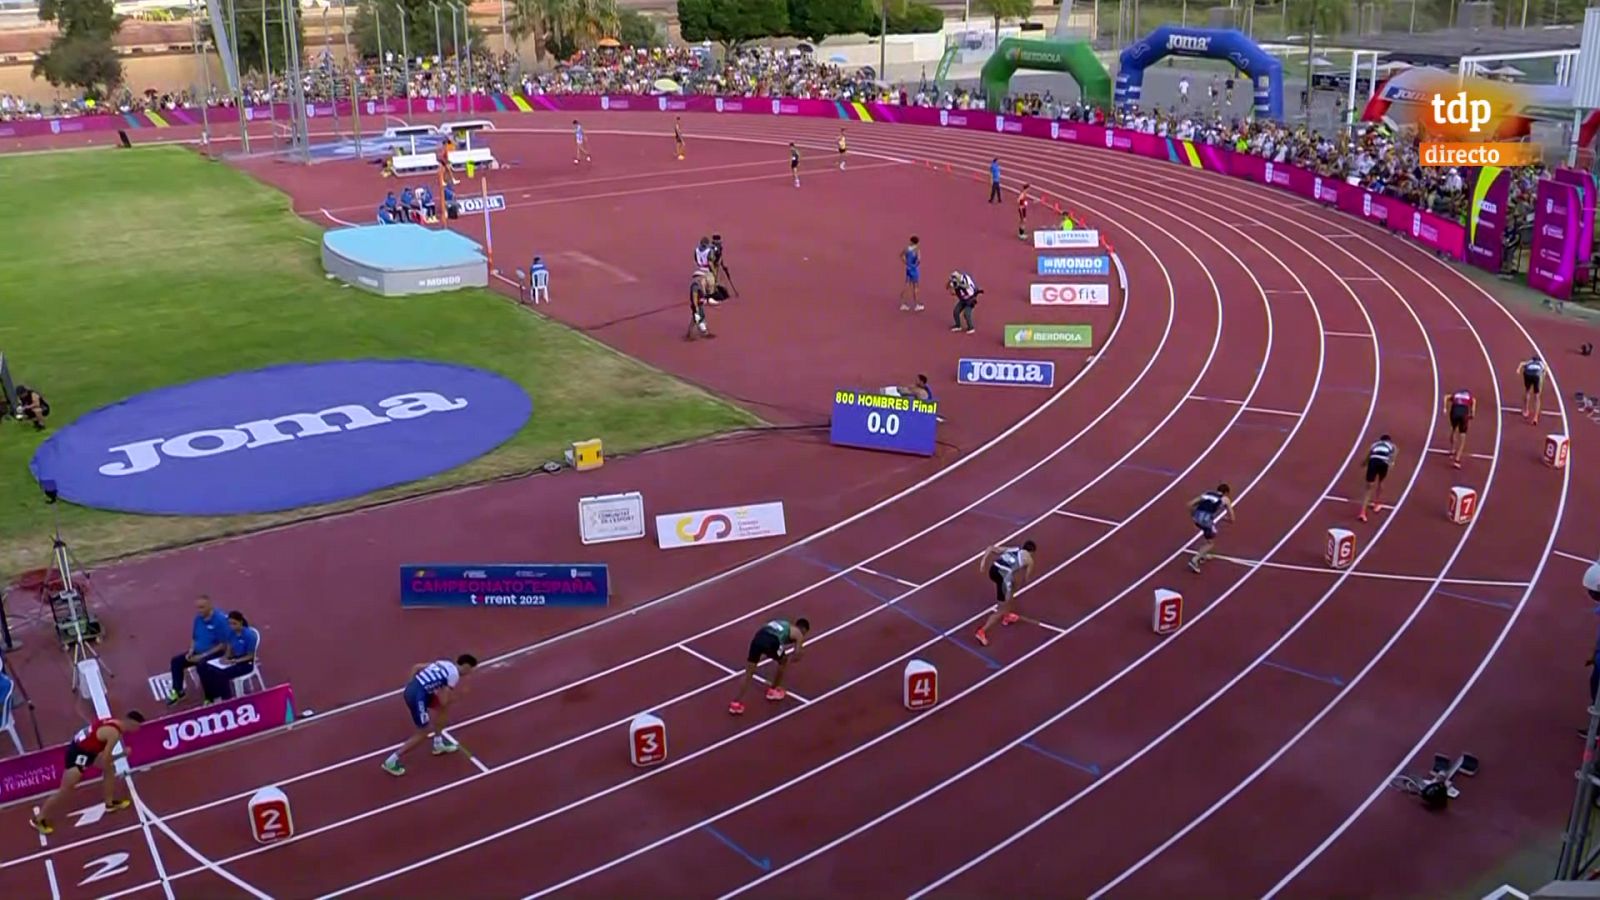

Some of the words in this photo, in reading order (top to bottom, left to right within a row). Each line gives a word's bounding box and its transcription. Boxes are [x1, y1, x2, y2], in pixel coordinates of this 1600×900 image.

[1054, 257, 1102, 268] MONDO
[835, 391, 855, 405] 800
[857, 393, 909, 411] HOMBRES
[912, 400, 937, 415] Final
[867, 411, 900, 436] 0.0
[1463, 497, 1473, 513] 7
[1341, 541, 1351, 558] 6
[412, 580, 524, 593] CAMPEONATO
[532, 578, 596, 593] ESPAÑA
[519, 595, 546, 605] 2023
[1163, 604, 1177, 623] 5
[913, 678, 931, 697] 4
[641, 732, 659, 753] 3
[260, 808, 282, 831] 2
[77, 852, 130, 887] 2
